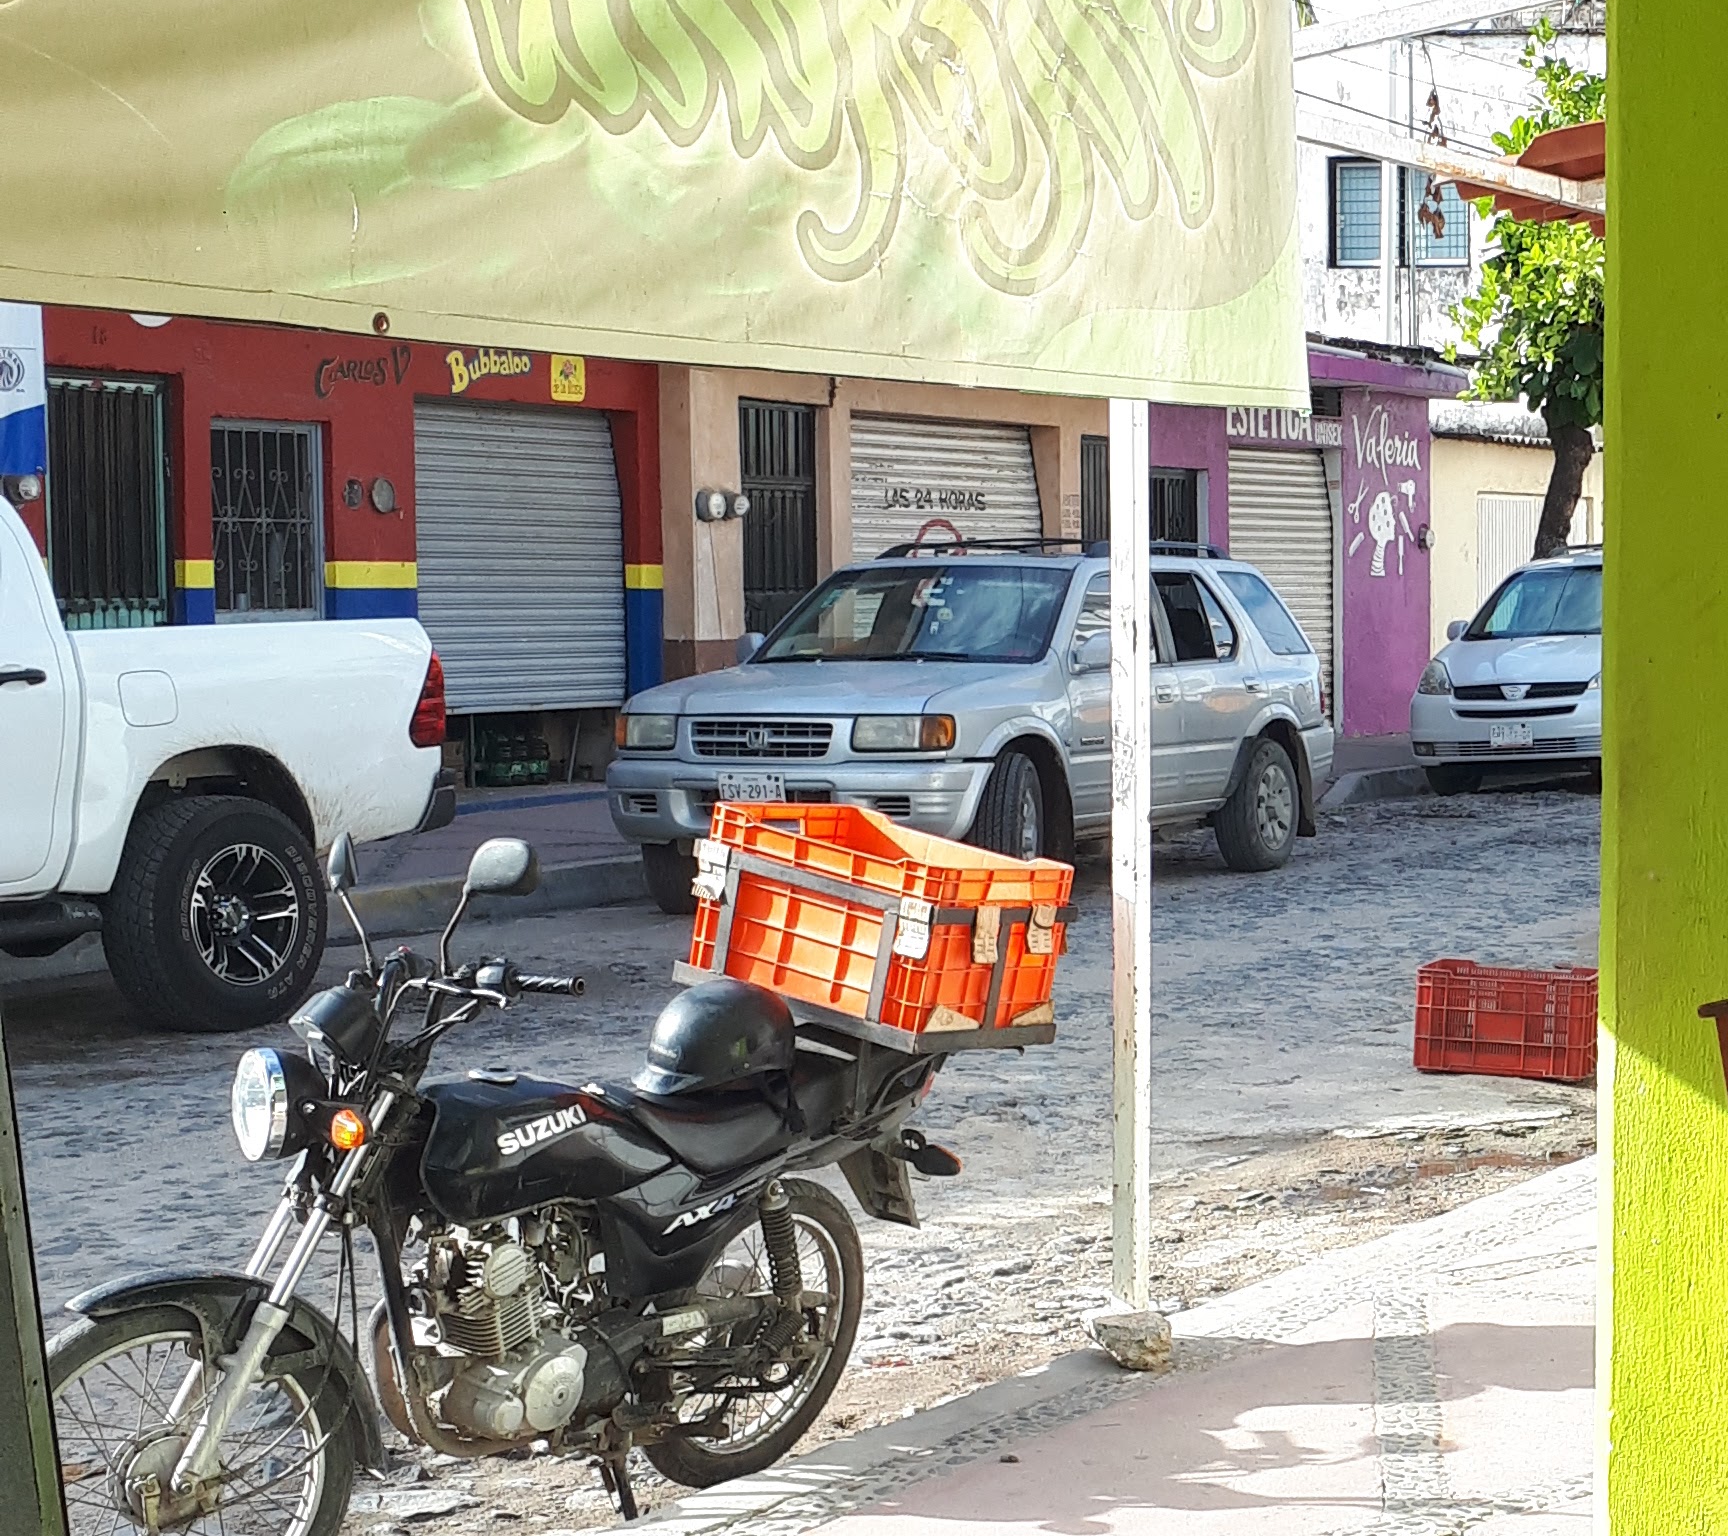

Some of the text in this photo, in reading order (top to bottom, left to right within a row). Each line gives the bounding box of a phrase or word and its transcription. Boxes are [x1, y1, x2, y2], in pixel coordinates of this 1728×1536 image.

[314, 345, 411, 399] CARLOS V
[446, 349, 531, 393] Bubbaloo
[1352, 405, 1421, 486] Valeria
[915, 488, 934, 510] 24
[938, 490, 986, 512] HORAS
[497, 1103, 587, 1156] SUZUKI
